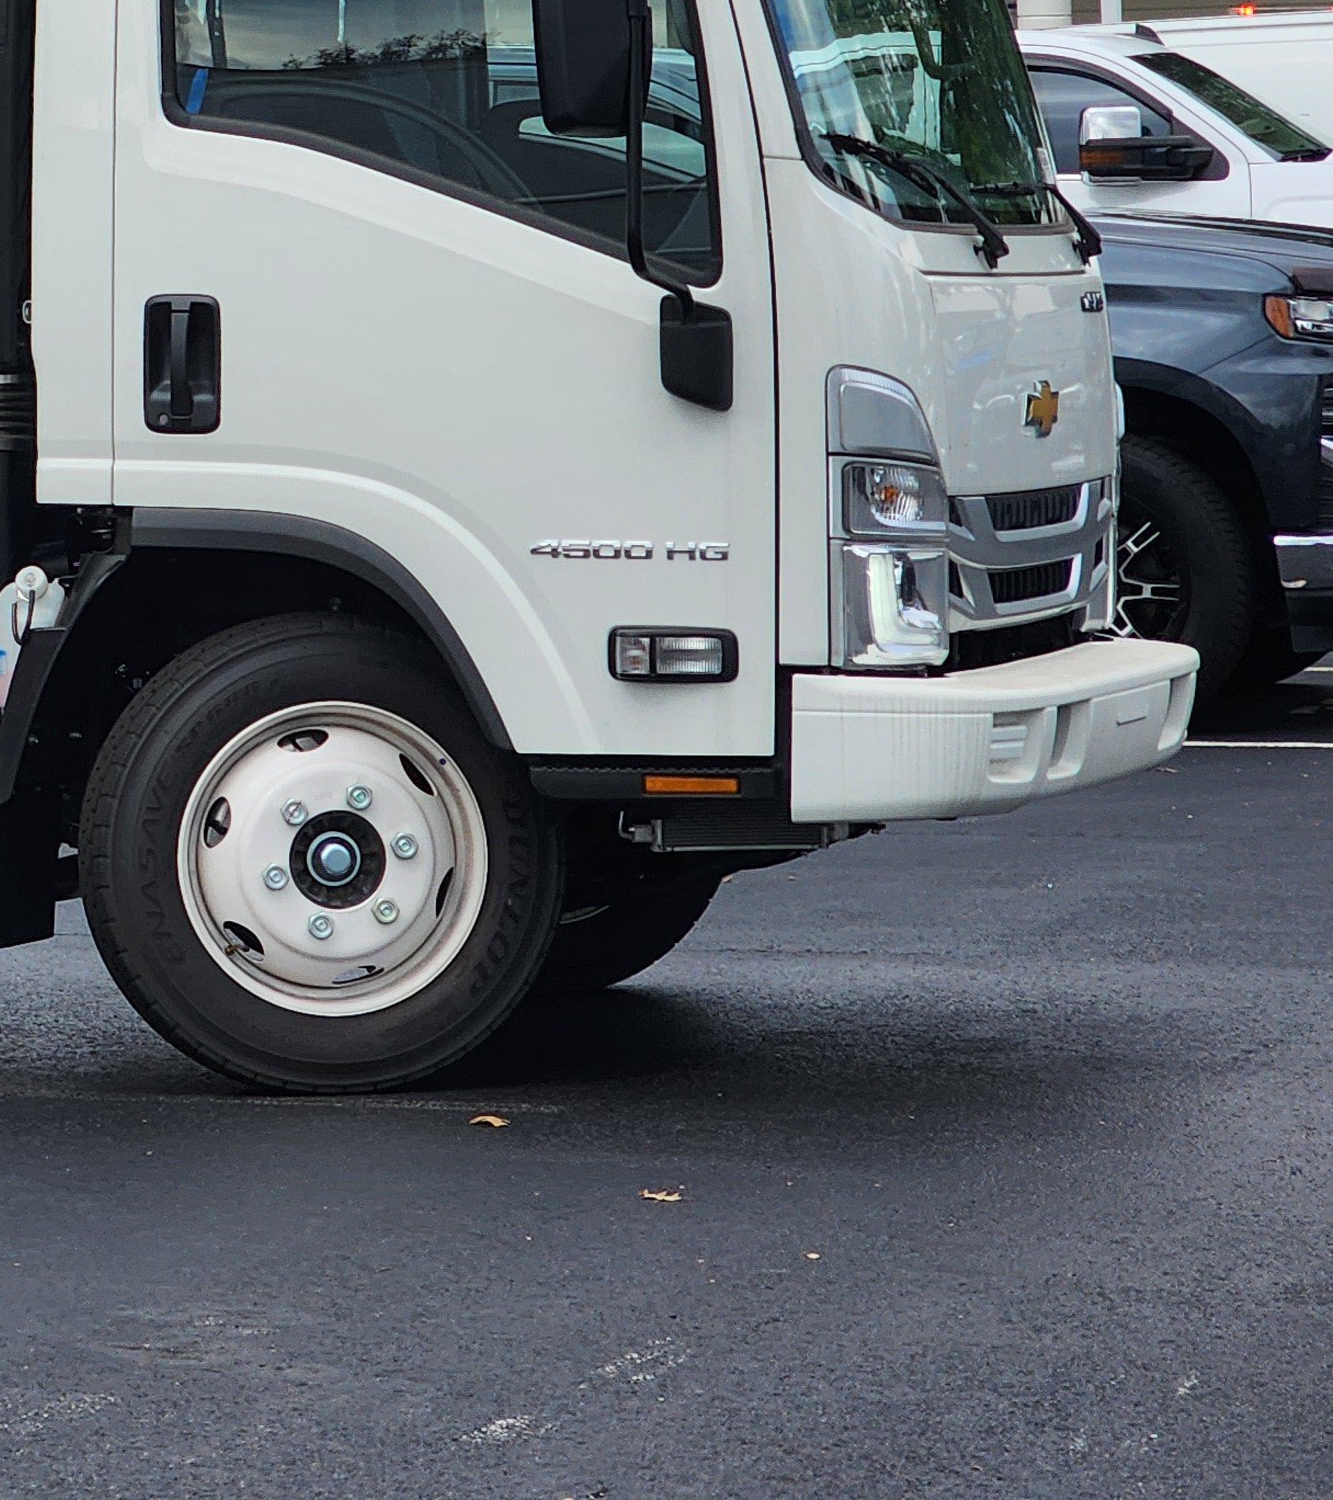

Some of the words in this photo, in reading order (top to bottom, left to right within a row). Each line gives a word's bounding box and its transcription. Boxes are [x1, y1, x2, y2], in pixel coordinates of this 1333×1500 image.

[530, 539, 654, 560] 4500
[665, 540, 730, 561] HG
[469, 798, 531, 998] DUNLOP
